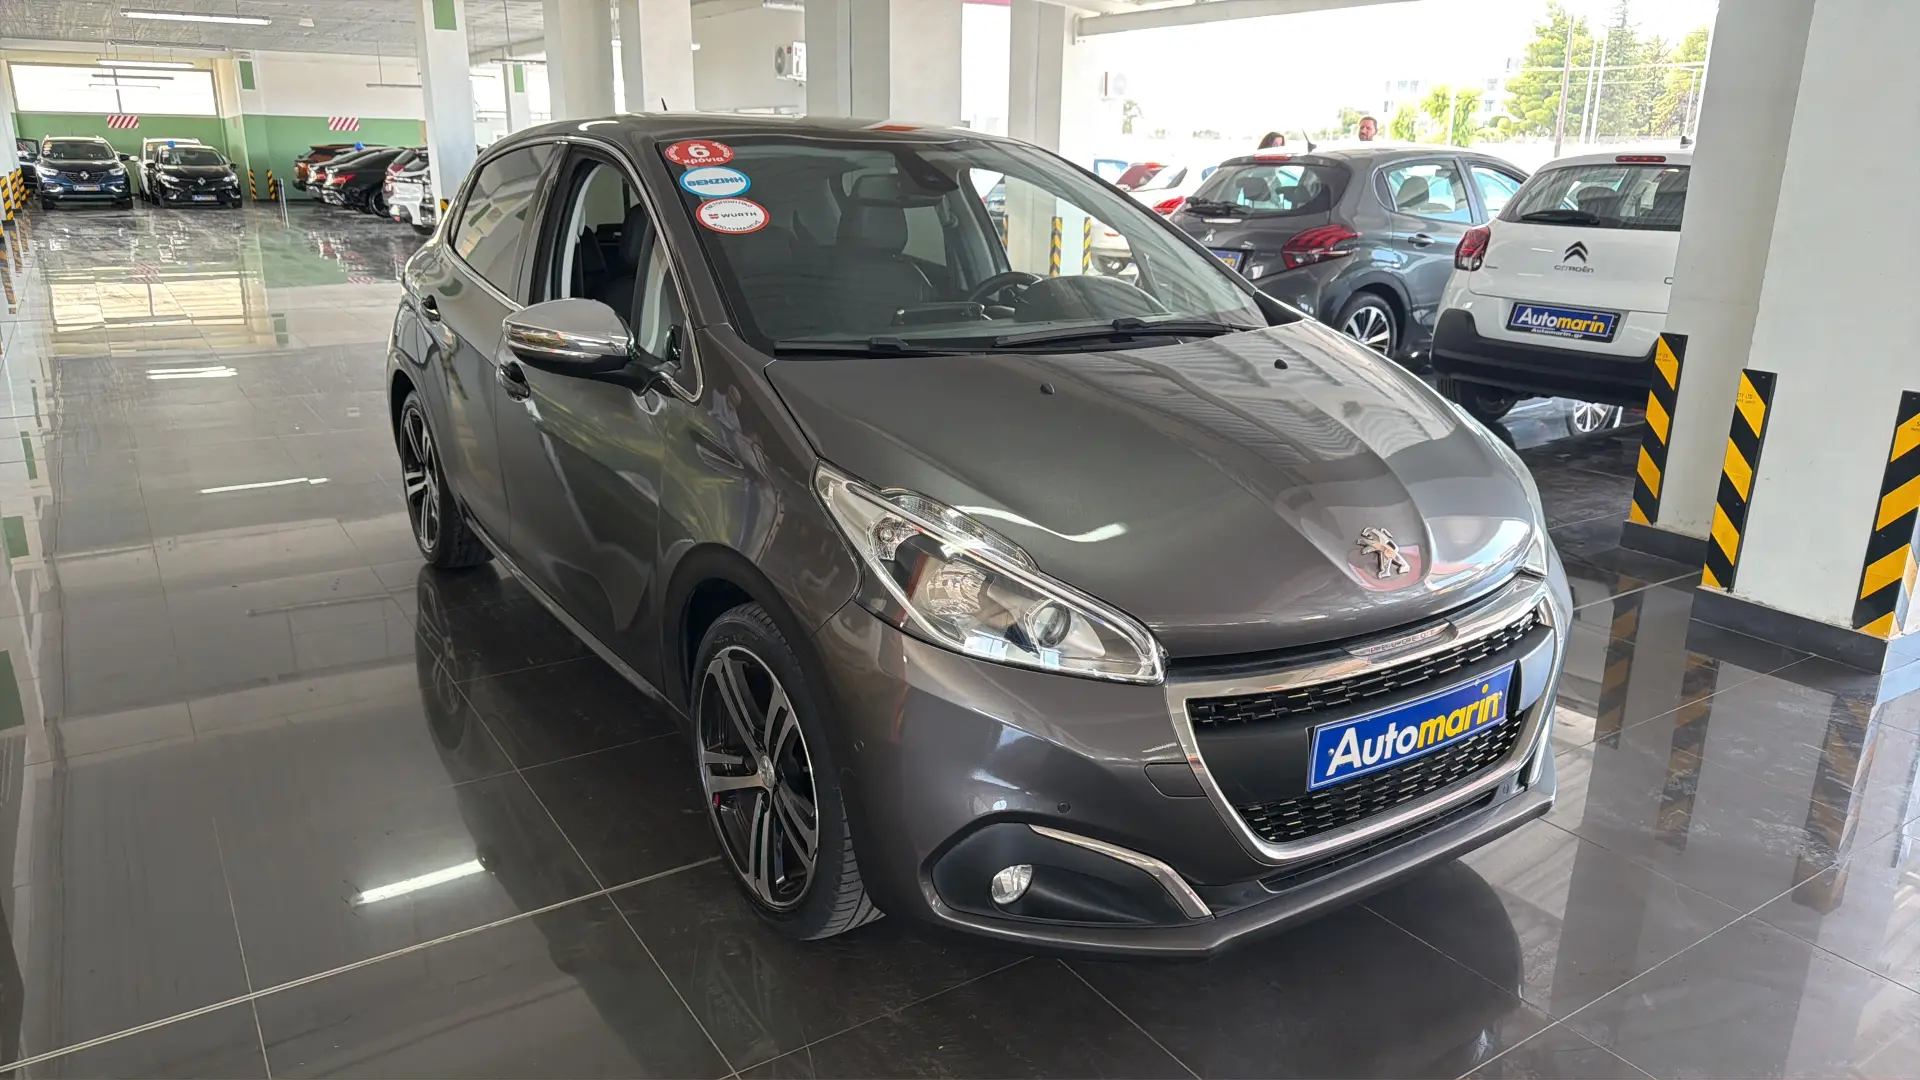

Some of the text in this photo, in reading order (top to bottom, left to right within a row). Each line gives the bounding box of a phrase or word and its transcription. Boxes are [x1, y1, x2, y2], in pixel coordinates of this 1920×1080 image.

[683, 156, 724, 165] χρόνια
[688, 145, 710, 158] 6
[1517, 307, 1606, 335] Automarin
[1531, 327, 1584, 339] Automarin.gr
[1369, 629, 1435, 654] PEUGEOT
[1325, 683, 1500, 777] Automarin
